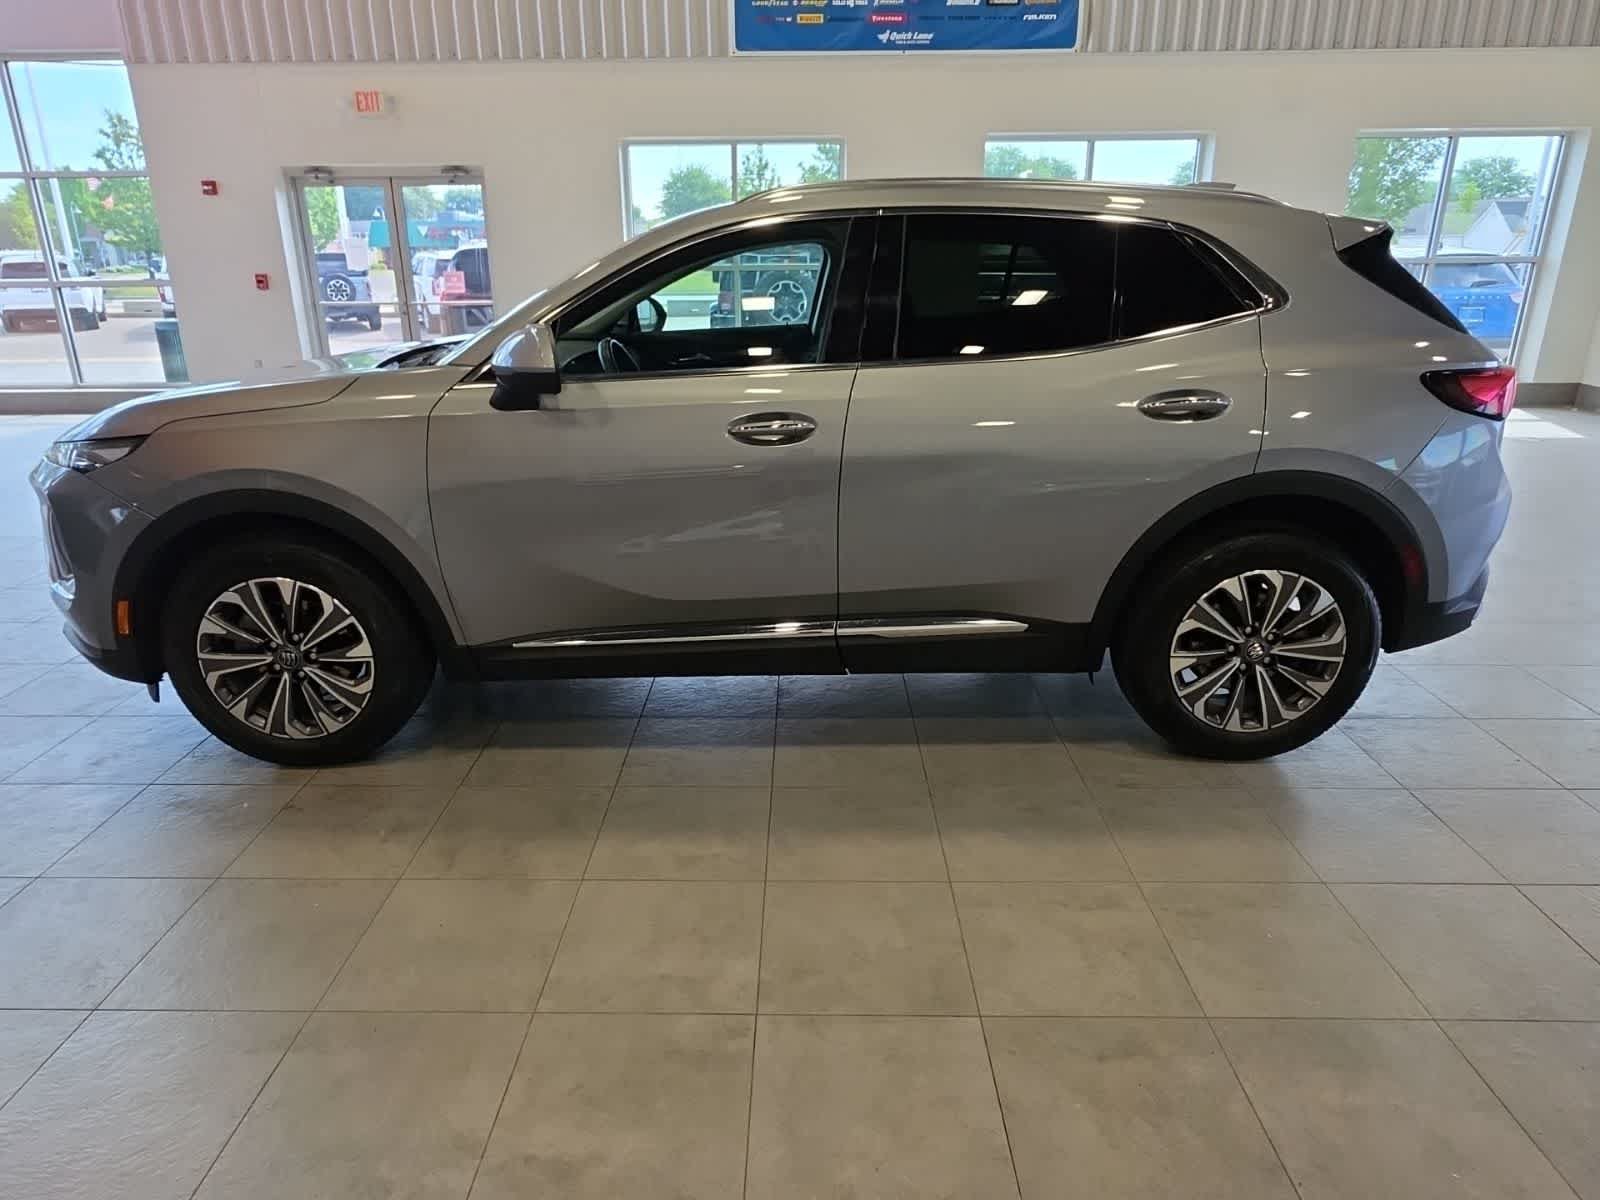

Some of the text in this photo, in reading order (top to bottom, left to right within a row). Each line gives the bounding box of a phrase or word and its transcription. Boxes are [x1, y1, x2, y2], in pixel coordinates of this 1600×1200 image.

[890, 31, 935, 40] Quick Lane
[355, 91, 380, 112] EXIT
